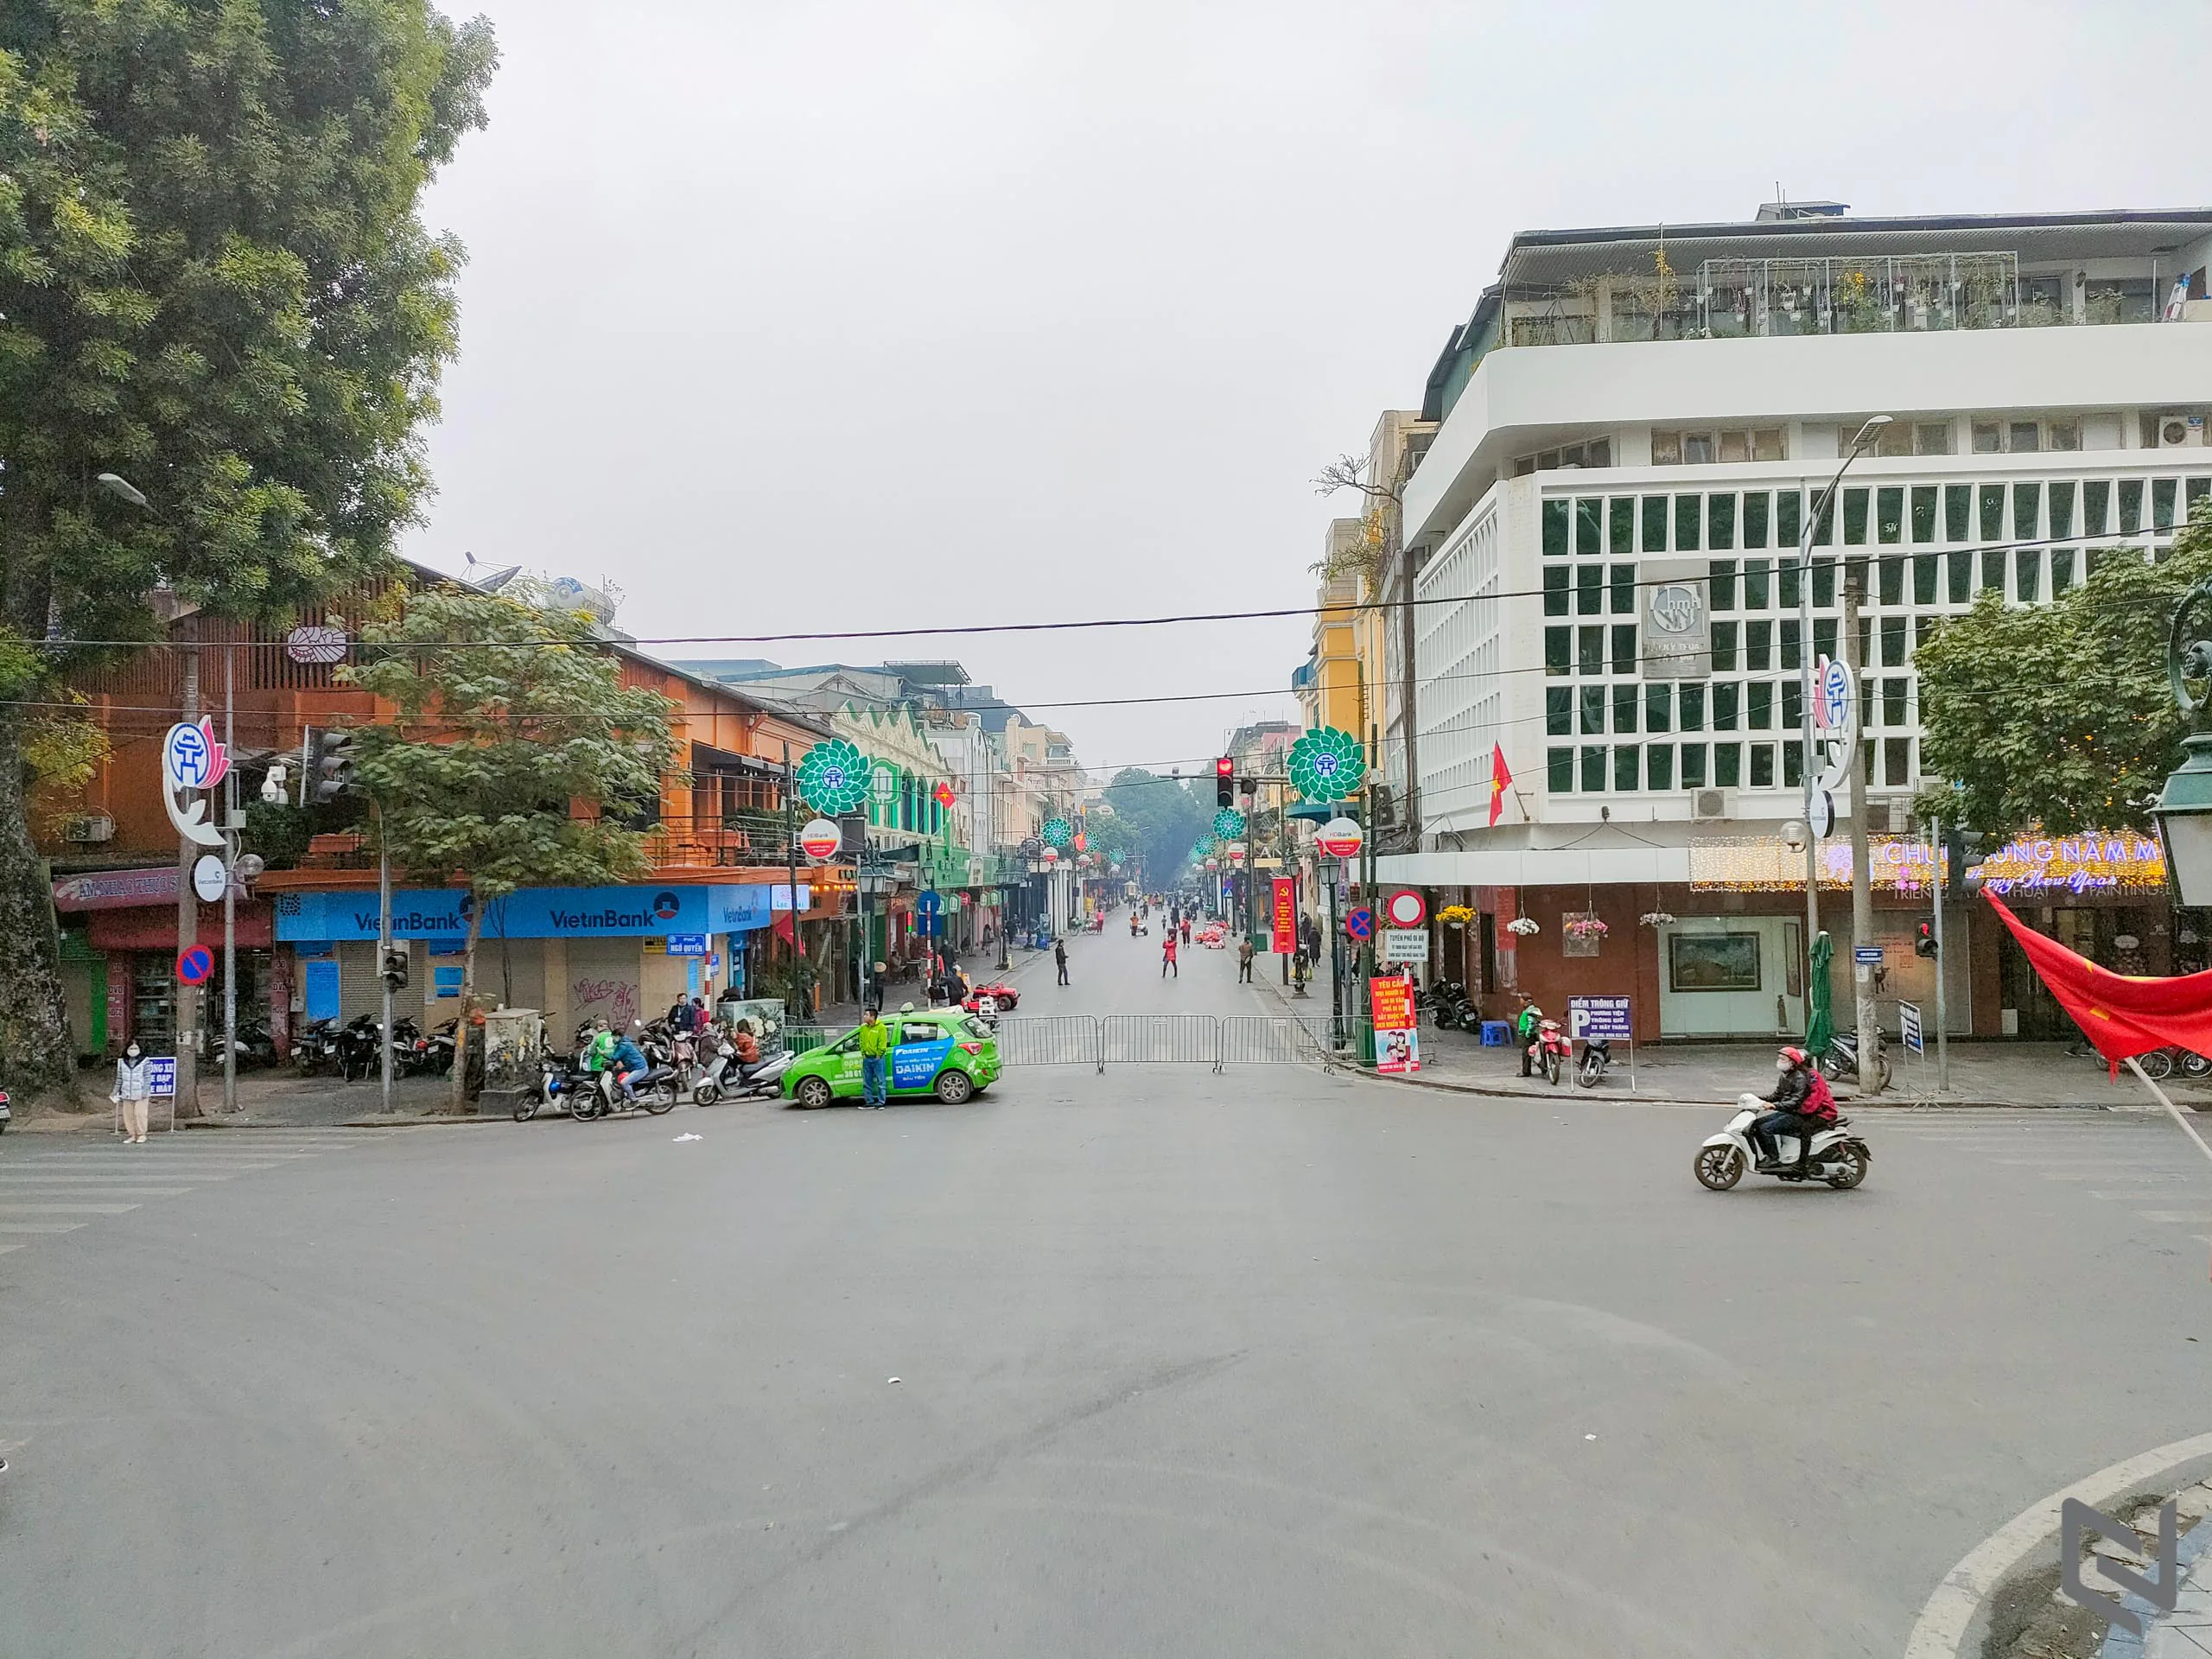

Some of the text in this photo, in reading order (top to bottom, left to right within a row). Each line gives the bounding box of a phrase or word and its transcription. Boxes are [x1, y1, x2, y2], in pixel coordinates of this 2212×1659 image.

[2017, 869, 2065, 888] New
[2067, 869, 2118, 894] Year
[354, 912, 461, 931] VieinBank
[550, 908, 655, 930] VietinBank
[723, 906, 753, 925] VietinBank
[670, 943, 683, 952] NGÔ
[1378, 981, 1390, 989] YÊU
[1570, 997, 1629, 1008] ĐIỂM TRÔNG GIỮ
[895, 1063, 935, 1074] DAIKIN
